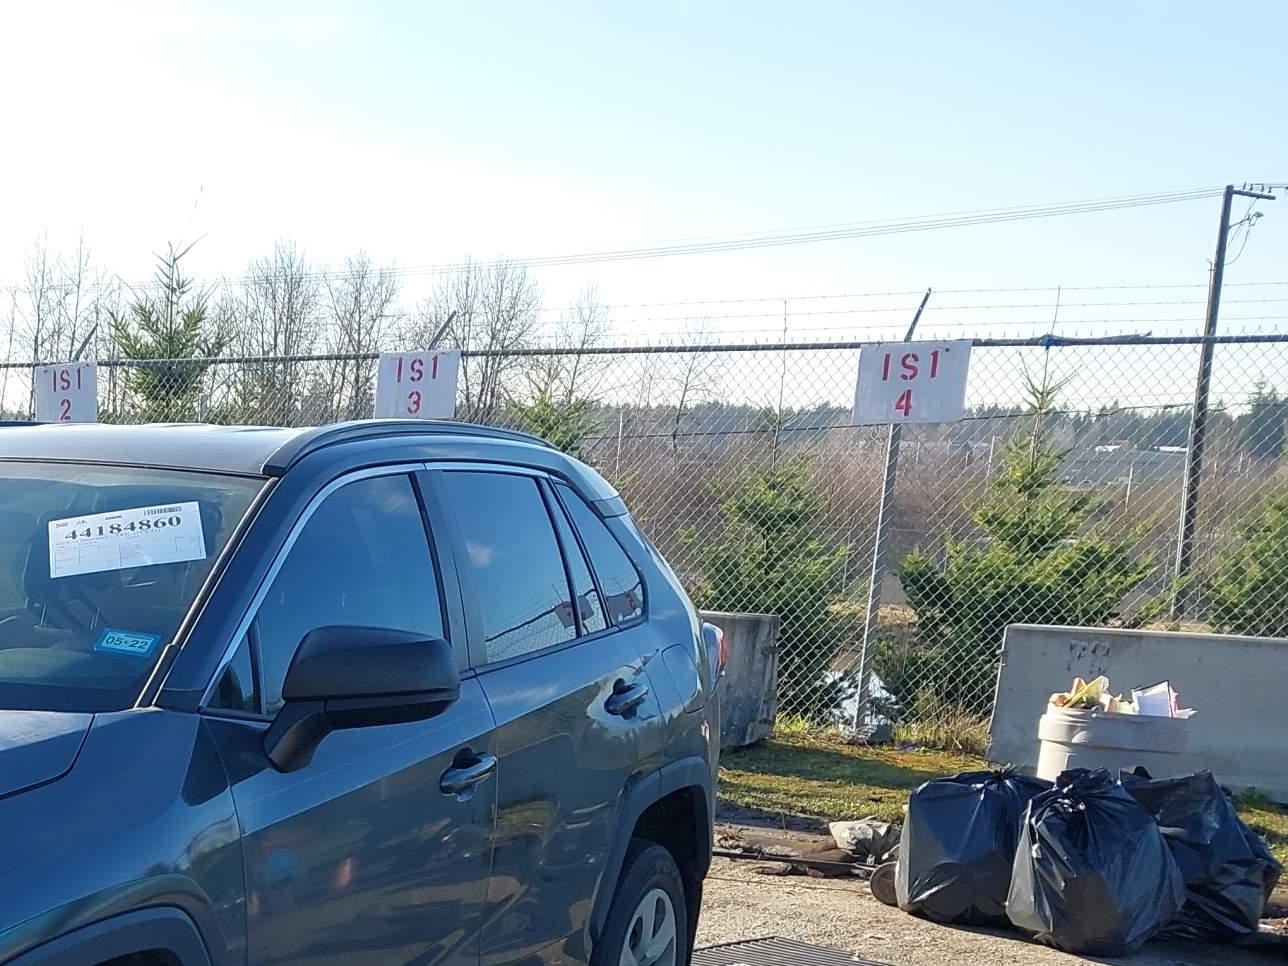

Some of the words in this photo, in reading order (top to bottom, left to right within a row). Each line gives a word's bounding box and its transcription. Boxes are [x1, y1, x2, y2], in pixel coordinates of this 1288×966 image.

[60, 398, 71, 421] 2
[407, 390, 421, 414] 3
[894, 389, 912, 417] 4
[64, 515, 182, 541] 44184860
